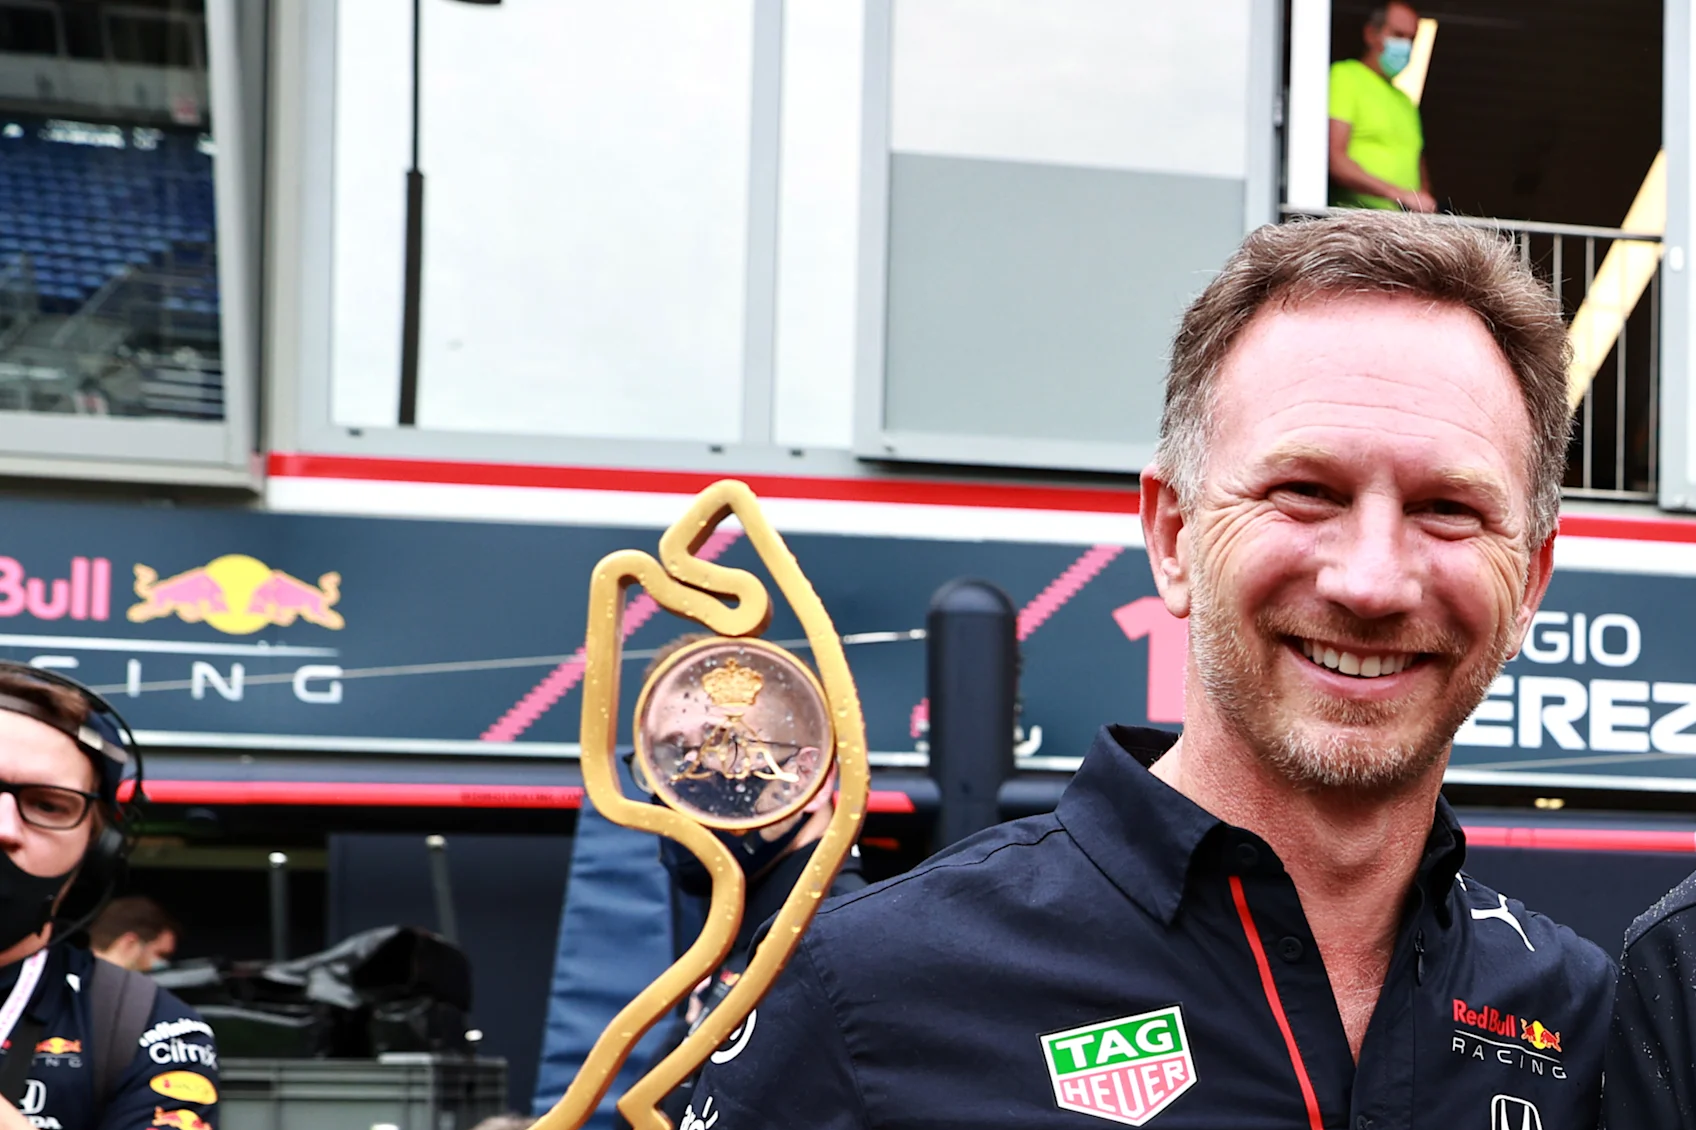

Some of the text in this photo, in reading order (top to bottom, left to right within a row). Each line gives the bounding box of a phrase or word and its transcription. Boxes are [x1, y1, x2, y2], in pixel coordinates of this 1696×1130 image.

[0, 556, 111, 621] Bull
[1508, 611, 1641, 667] GIO
[1055, 1018, 1175, 1070] TAG
[1453, 998, 1517, 1039] Red Bull
[1452, 1036, 1567, 1080] RACING
[1063, 1059, 1186, 1119] HEUER
